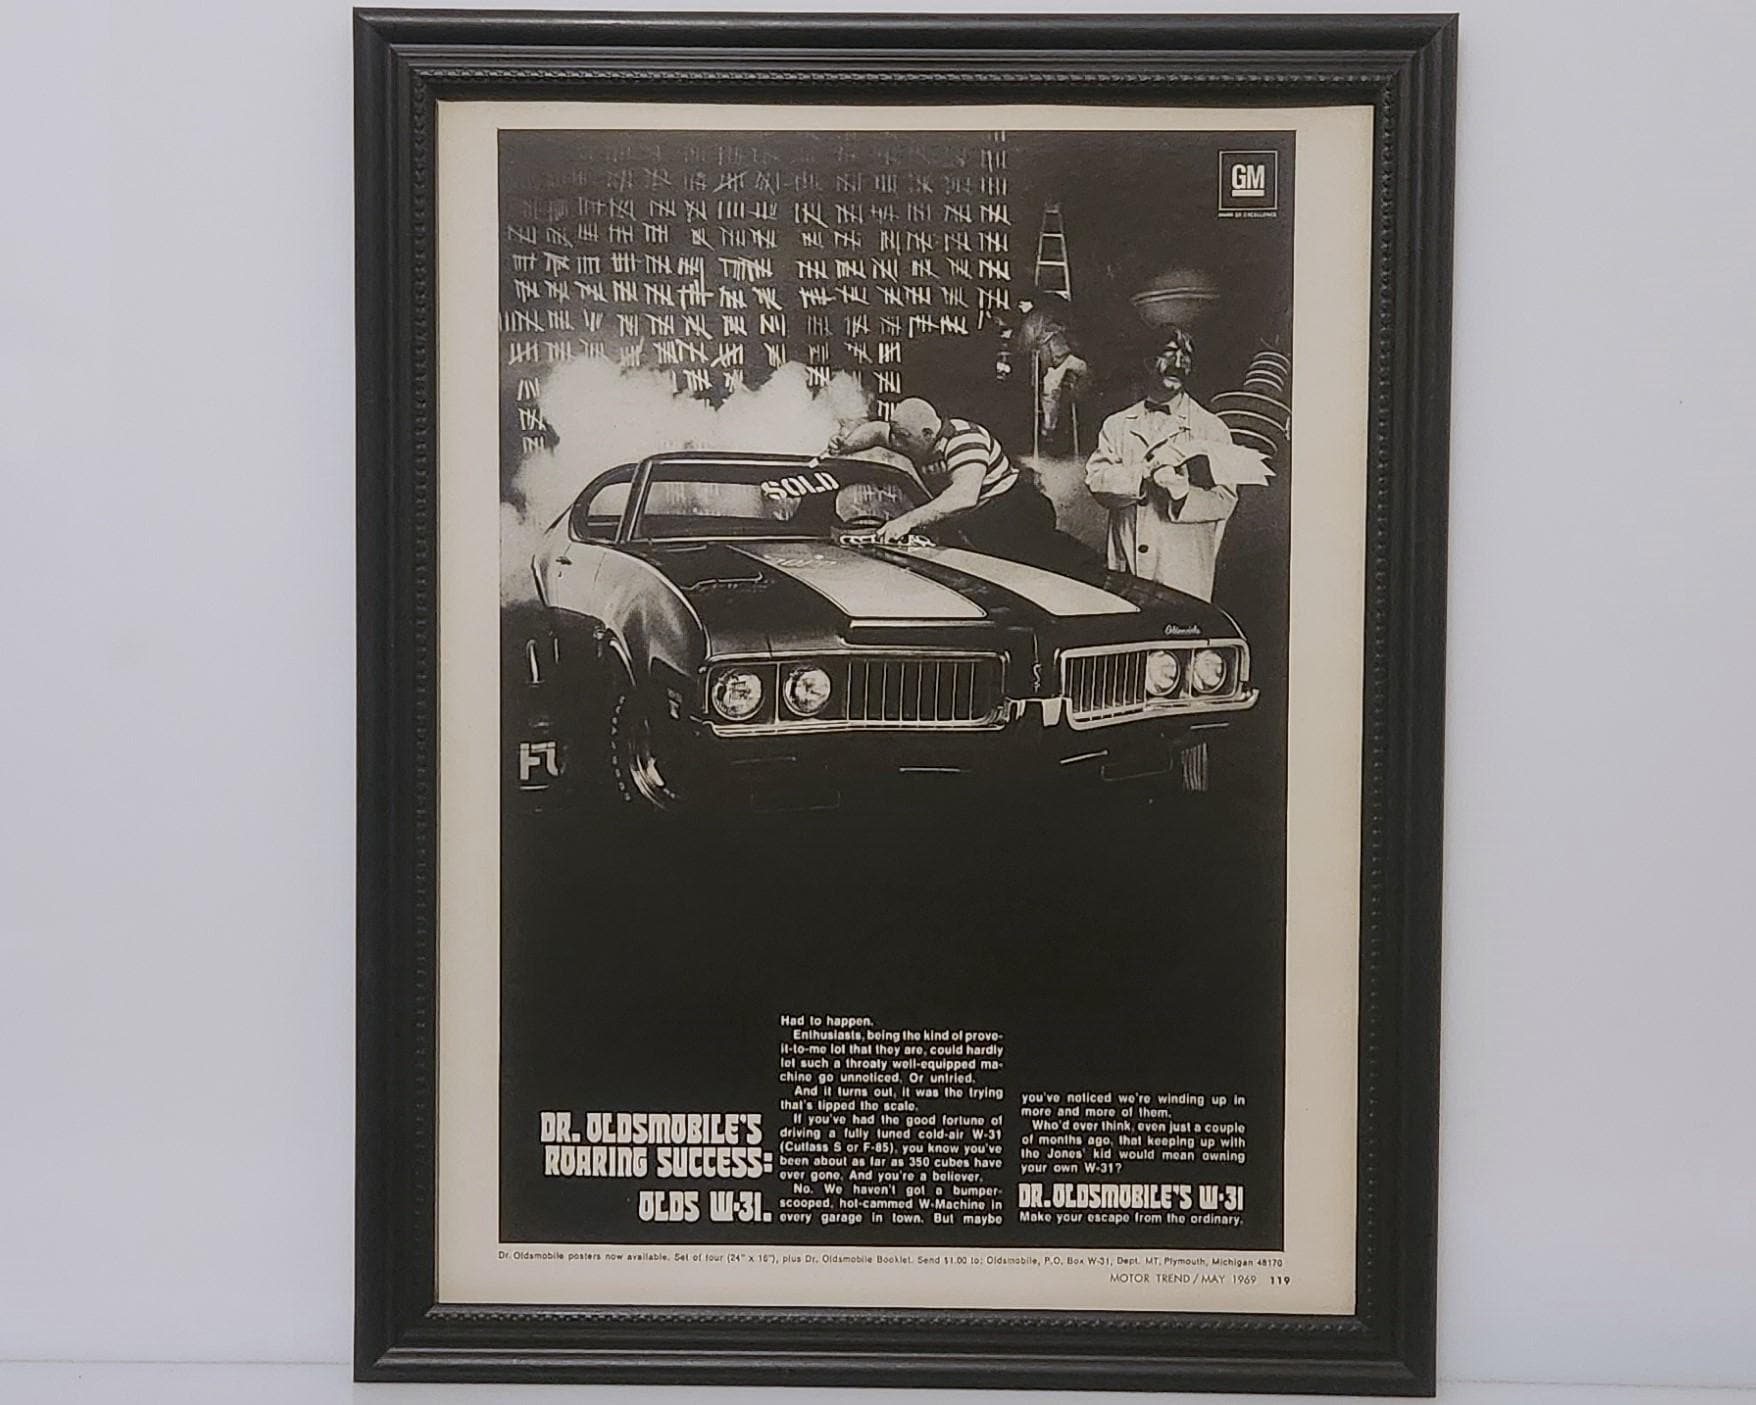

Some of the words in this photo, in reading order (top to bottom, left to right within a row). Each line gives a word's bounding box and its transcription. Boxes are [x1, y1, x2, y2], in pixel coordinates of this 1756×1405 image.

[1231, 164, 1265, 190] GM
[761, 472, 840, 500] SOLD
[781, 1015, 805, 1026] Had
[826, 1016, 874, 1028] happen.
[793, 1029, 865, 1042] Enthusiasts,
[867, 1029, 901, 1042] being
[903, 1030, 921, 1041] the
[924, 1030, 950, 1041] kind
[951, 1030, 963, 1041] of
[965, 1032, 1003, 1042] prove-
[781, 1043, 827, 1054] it-to-me
[830, 1043, 846, 1055] lot
[849, 1044, 872, 1055] that
[875, 1044, 901, 1056] they
[904, 1046, 927, 1056] are,
[930, 1044, 963, 1056] could
[966, 1045, 1003, 1057] hardly
[781, 1057, 795, 1068] let
[800, 1058, 829, 1068] such
[845, 1058, 888, 1071] throaty
[892, 1058, 976, 1071] well-equipped
[981, 1061, 1003, 1070] ma-
[780, 1072, 812, 1082] chine
[818, 1073, 834, 1084] go
[840, 1072, 902, 1083] unnoticed.
[909, 1072, 924, 1084] Or
[930, 1073, 976, 1084] untried.
[794, 1086, 818, 1096] And
[838, 1086, 868, 1097] turns
[874, 1087, 897, 1098] out,
[916, 1089, 939, 1098] was
[945, 1087, 963, 1098] the
[969, 1087, 1004, 1100] trying
[1022, 1092, 1060, 1105] you've
[1067, 1093, 1112, 1103] noticed
[1118, 1093, 1151, 1104] we're
[1158, 1093, 1204, 1106] winding
[1212, 1096, 1227, 1107] up
[781, 1100, 813, 1110] that's
[818, 1100, 855, 1112] tipped
[860, 1100, 879, 1111] the
[884, 1101, 918, 1111] scale.
[1021, 1108, 1052, 1117] more
[1057, 1107, 1080, 1117] and
[1085, 1108, 1116, 1117] more
[1139, 1107, 1172, 1118] them.
[808, 1114, 847, 1126] you've
[852, 1114, 875, 1125] had
[881, 1114, 900, 1125] the
[906, 1115, 936, 1127] good
[942, 1115, 985, 1126] fortune
[991, 1115, 1003, 1126] of
[1032, 1120, 1070, 1130] Who'd
[1073, 1122, 1098, 1132] ever
[1101, 1121, 1135, 1132] think,
[1137, 1123, 1166, 1132] even
[1169, 1121, 1191, 1134] just
[1204, 1122, 1245, 1135] couple
[541, 1112, 580, 1142] DR.
[587, 1113, 762, 1145] OLDSMOBILE'S
[780, 1128, 821, 1140] driving
[844, 1128, 869, 1140] fully
[877, 1128, 911, 1139] tuned
[918, 1129, 964, 1140] cold-air
[972, 1129, 1001, 1140] W-31
[780, 1142, 829, 1153] (Cutlass
[863, 1142, 898, 1155] F-85),
[902, 1145, 924, 1155] you
[928, 1143, 959, 1154] know
[964, 1143, 1002, 1155] you've
[1022, 1134, 1034, 1145] of
[1039, 1135, 1082, 1145] months
[1088, 1136, 1113, 1147] ago,
[1119, 1135, 1142, 1146] that
[1147, 1136, 1195, 1149] keeping
[1200, 1138, 1215, 1149] up
[1220, 1137, 1246, 1148] with
[545, 1145, 647, 1177] ROARING
[657, 1147, 773, 1178] SUCCESS:
[780, 1156, 809, 1166] been
[813, 1156, 847, 1166] about
[870, 1156, 886, 1167] far
[909, 1157, 930, 1167] 350
[934, 1157, 970, 1168] cubes
[974, 1157, 1002, 1168] have
[1021, 1149, 1040, 1159] the
[1047, 1149, 1086, 1159] Jones'
[1093, 1150, 1112, 1159] kid
[1119, 1150, 1155, 1160] would
[1162, 1152, 1195, 1161] mean
[1202, 1150, 1245, 1164] owning
[1021, 1164, 1047, 1175] your
[1053, 1165, 1078, 1173] own
[1084, 1163, 1122, 1174] W-31?
[779, 1171, 805, 1180] ever
[810, 1171, 843, 1182] gone.
[849, 1171, 873, 1180] And
[878, 1171, 915, 1183] you're
[932, 1171, 983, 1182] believer.
[794, 1183, 814, 1194] No.
[824, 1184, 843, 1195] We
[853, 1184, 896, 1195] haven't
[906, 1185, 925, 1197] got
[953, 1185, 1002, 1198] bumper-
[1019, 1183, 1051, 1208] DR.
[1053, 1184, 1192, 1210] OLDSMOBILE'S
[639, 1191, 700, 1222] OLDS
[710, 1191, 772, 1222] W-31.
[780, 1198, 834, 1210] scooped,
[839, 1198, 913, 1209] hot-cammed
[919, 1199, 985, 1210] W-Machine
[780, 1213, 812, 1224] every
[821, 1213, 862, 1225] garage
[892, 1213, 924, 1223] town.
[934, 1213, 954, 1224] But
[963, 1214, 1002, 1226] maybe
[1020, 1211, 1052, 1222] Make
[1056, 1214, 1083, 1225] your
[1087, 1214, 1130, 1225] escape
[1135, 1212, 1162, 1223] from
[1167, 1213, 1186, 1224] the
[1190, 1213, 1243, 1227] ordinary.
[498, 1251, 511, 1260] Dr.
[513, 1251, 564, 1260] Oldsmobile
[568, 1253, 601, 1261] posters
[627, 1253, 670, 1261] available.
[674, 1253, 689, 1262] Set
[705, 1254, 723, 1262] four
[782, 1255, 802, 1264] plus
[805, 1254, 819, 1263] Dr.
[822, 1254, 873, 1264] Oldsmobile
[877, 1255, 913, 1264] Booklet.
[918, 1256, 940, 1264] Send
[944, 1256, 967, 1265] $1.00
[971, 1257, 983, 1265] to:
[986, 1256, 1041, 1266] Oldsmobile,
[1044, 1256, 1064, 1266] P.O.
[1067, 1257, 1084, 1265] Box
[1088, 1257, 1113, 1267] W-31,
[1117, 1256, 1140, 1266] Dept.
[1146, 1257, 1162, 1266] MT,
[1164, 1257, 1209, 1267] Plymouth,
[1212, 1258, 1254, 1268] Michigan
[1257, 1259, 1283, 1268] 48170
[1110, 1273, 1150, 1284] MOTOR
[1233, 1274, 1257, 1285] 1969
[1270, 1276, 1291, 1286] 119
